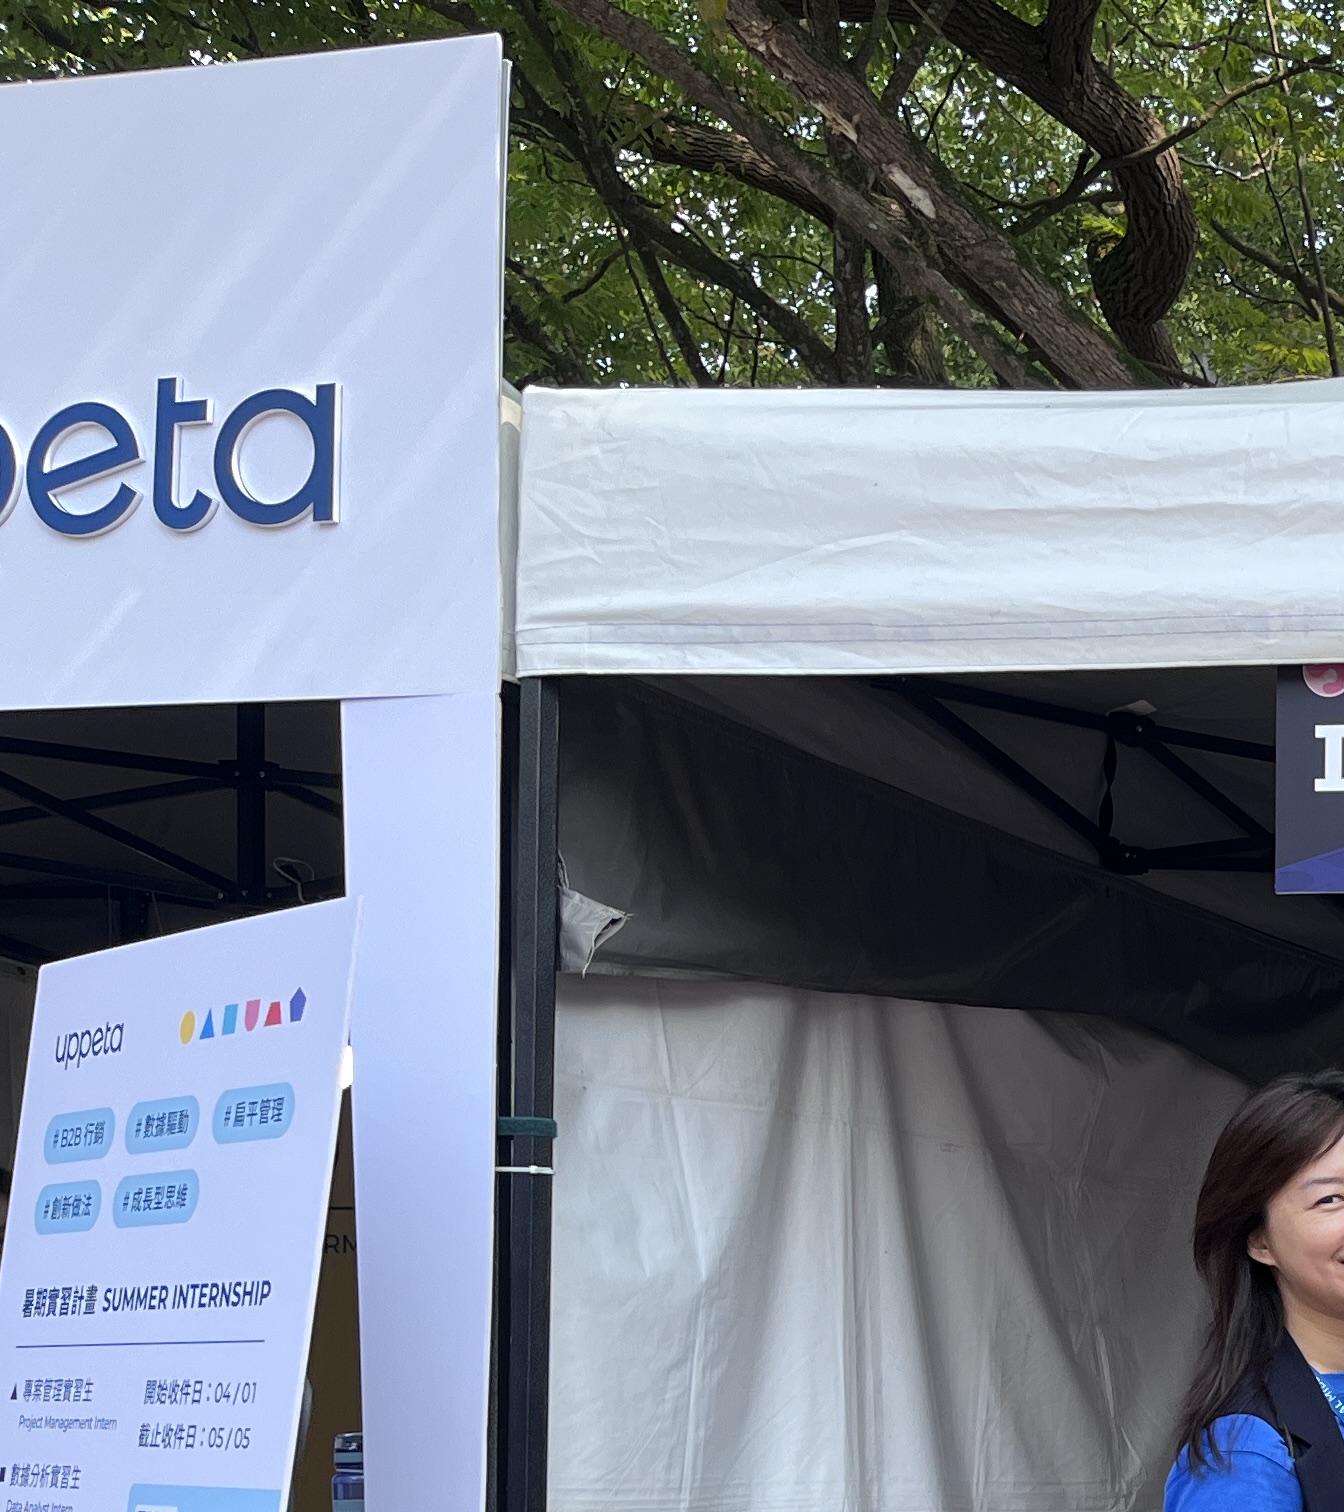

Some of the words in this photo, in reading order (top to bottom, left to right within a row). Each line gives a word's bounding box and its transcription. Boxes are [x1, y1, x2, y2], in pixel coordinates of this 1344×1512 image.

[0, 377, 343, 538] eta
[55, 1021, 125, 1071] uppeta
[22, 1285, 98, 1318] 暑期實習計畫
[102, 1285, 168, 1312] SUMMER
[172, 1279, 272, 1309] INTERNSHIP
[19, 1415, 43, 1432] Project
[44, 1416, 93, 1432] Management
[94, 1416, 117, 1430] Intern
